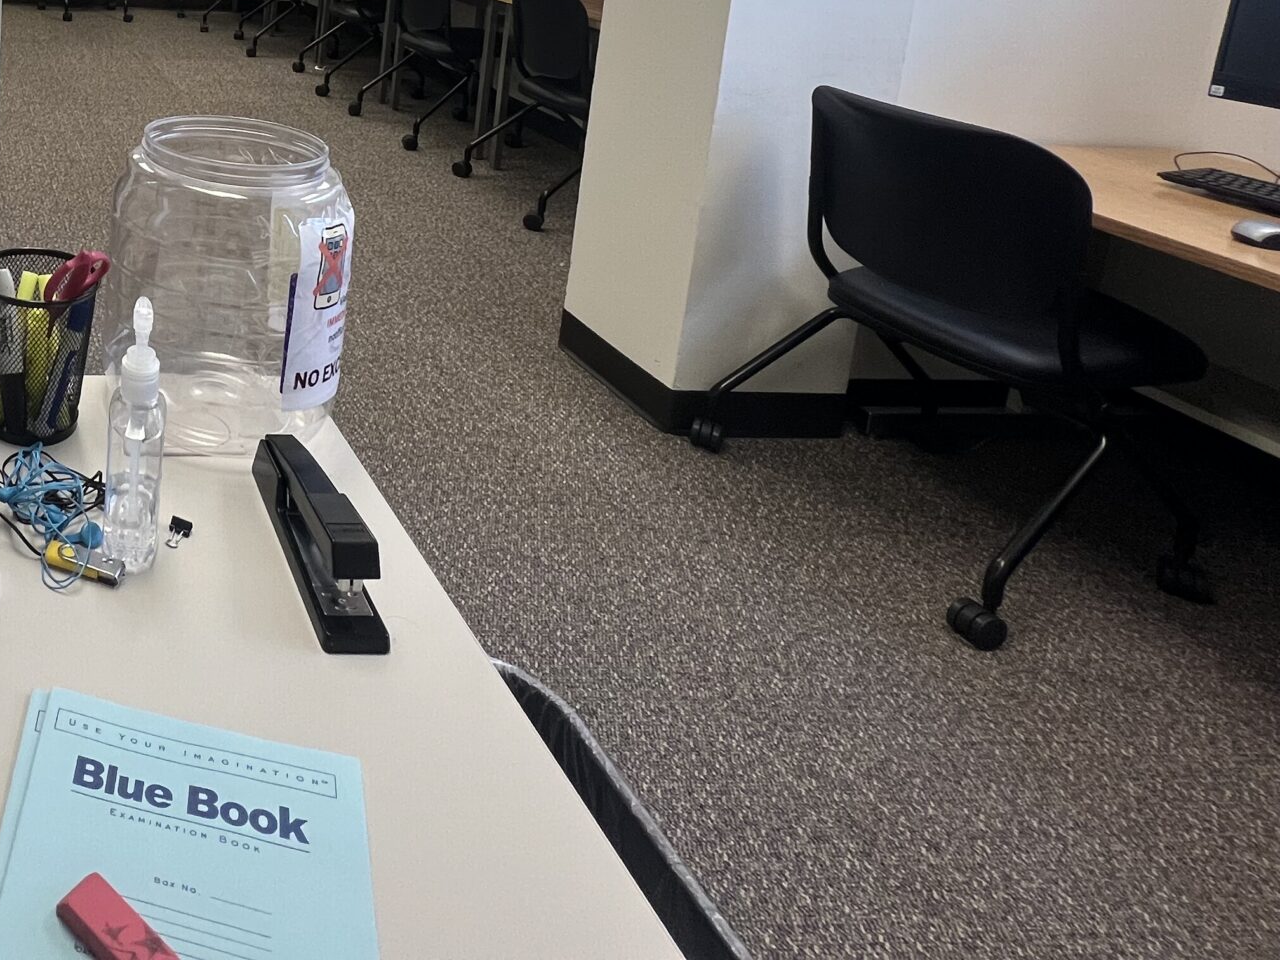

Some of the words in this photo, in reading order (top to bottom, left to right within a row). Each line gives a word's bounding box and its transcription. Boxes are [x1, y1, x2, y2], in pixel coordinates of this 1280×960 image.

[293, 369, 320, 390] NO
[69, 718, 102, 734] USE
[119, 733, 166, 752] YOUR
[72, 755, 174, 808] Blue
[186, 784, 310, 845] Book
